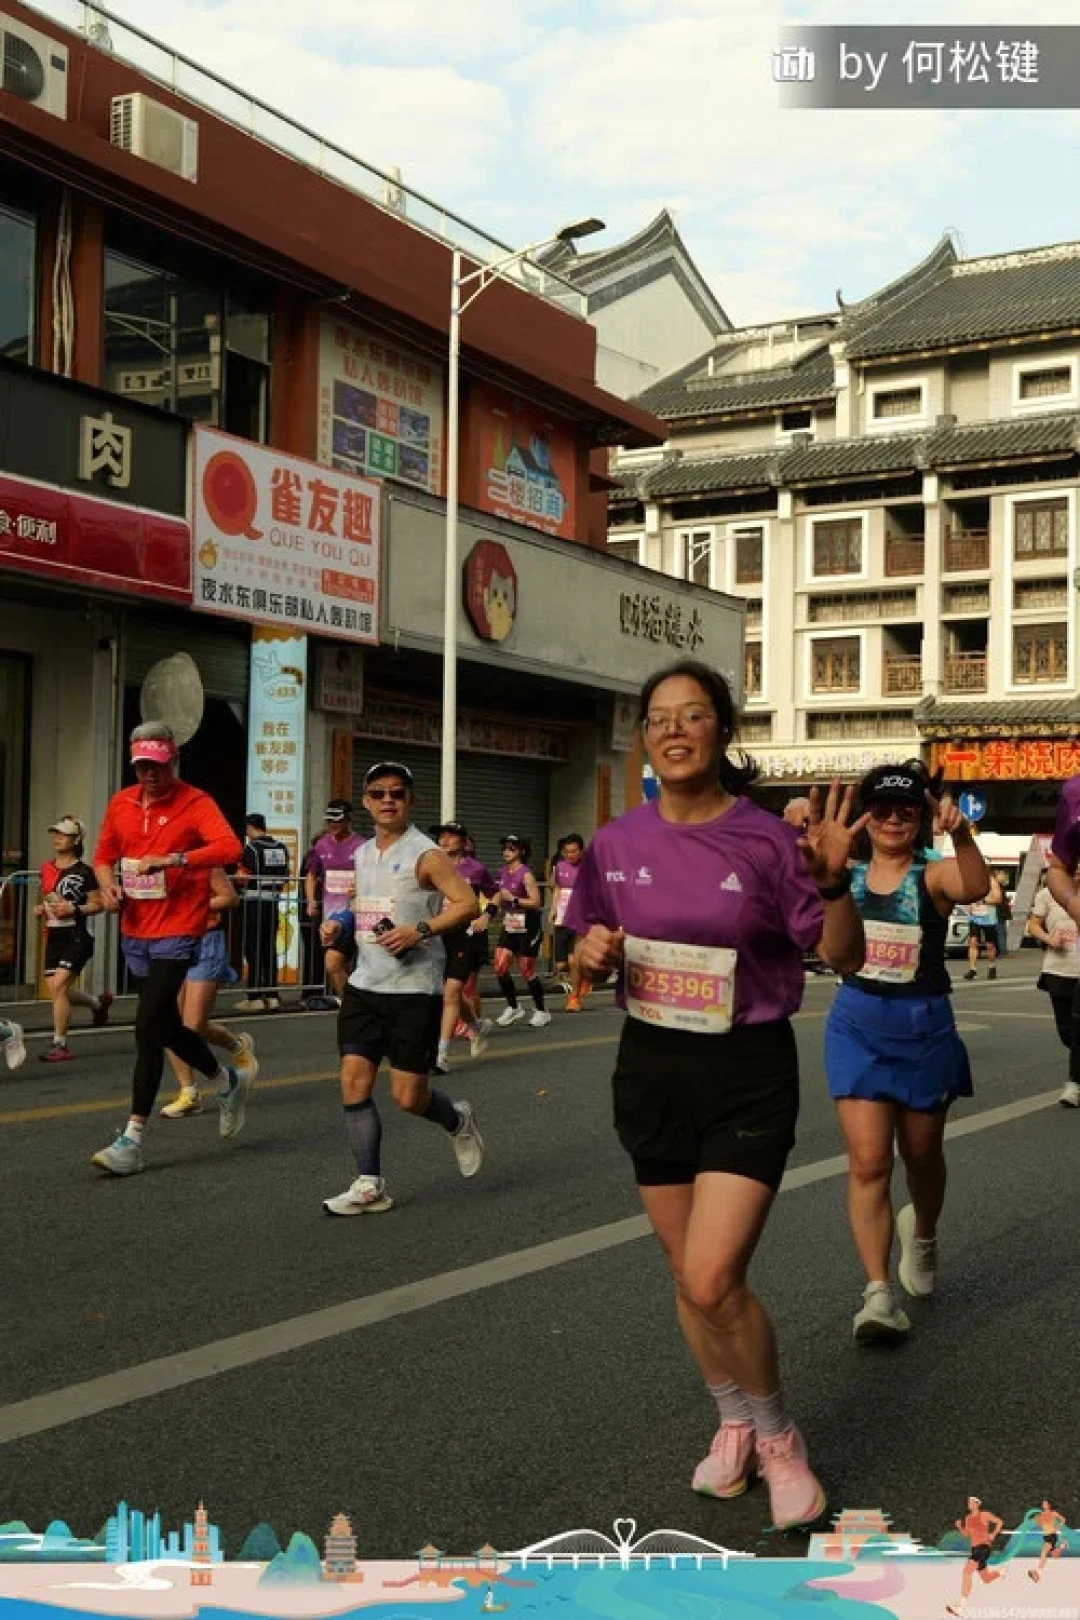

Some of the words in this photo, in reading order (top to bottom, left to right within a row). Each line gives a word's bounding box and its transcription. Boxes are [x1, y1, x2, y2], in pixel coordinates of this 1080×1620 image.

[78, 412, 132, 487] 肉
[270, 467, 373, 545] 雀友趣
[270, 527, 304, 551] QUE
[311, 538, 342, 560] YOU
[348, 548, 370, 567] QU
